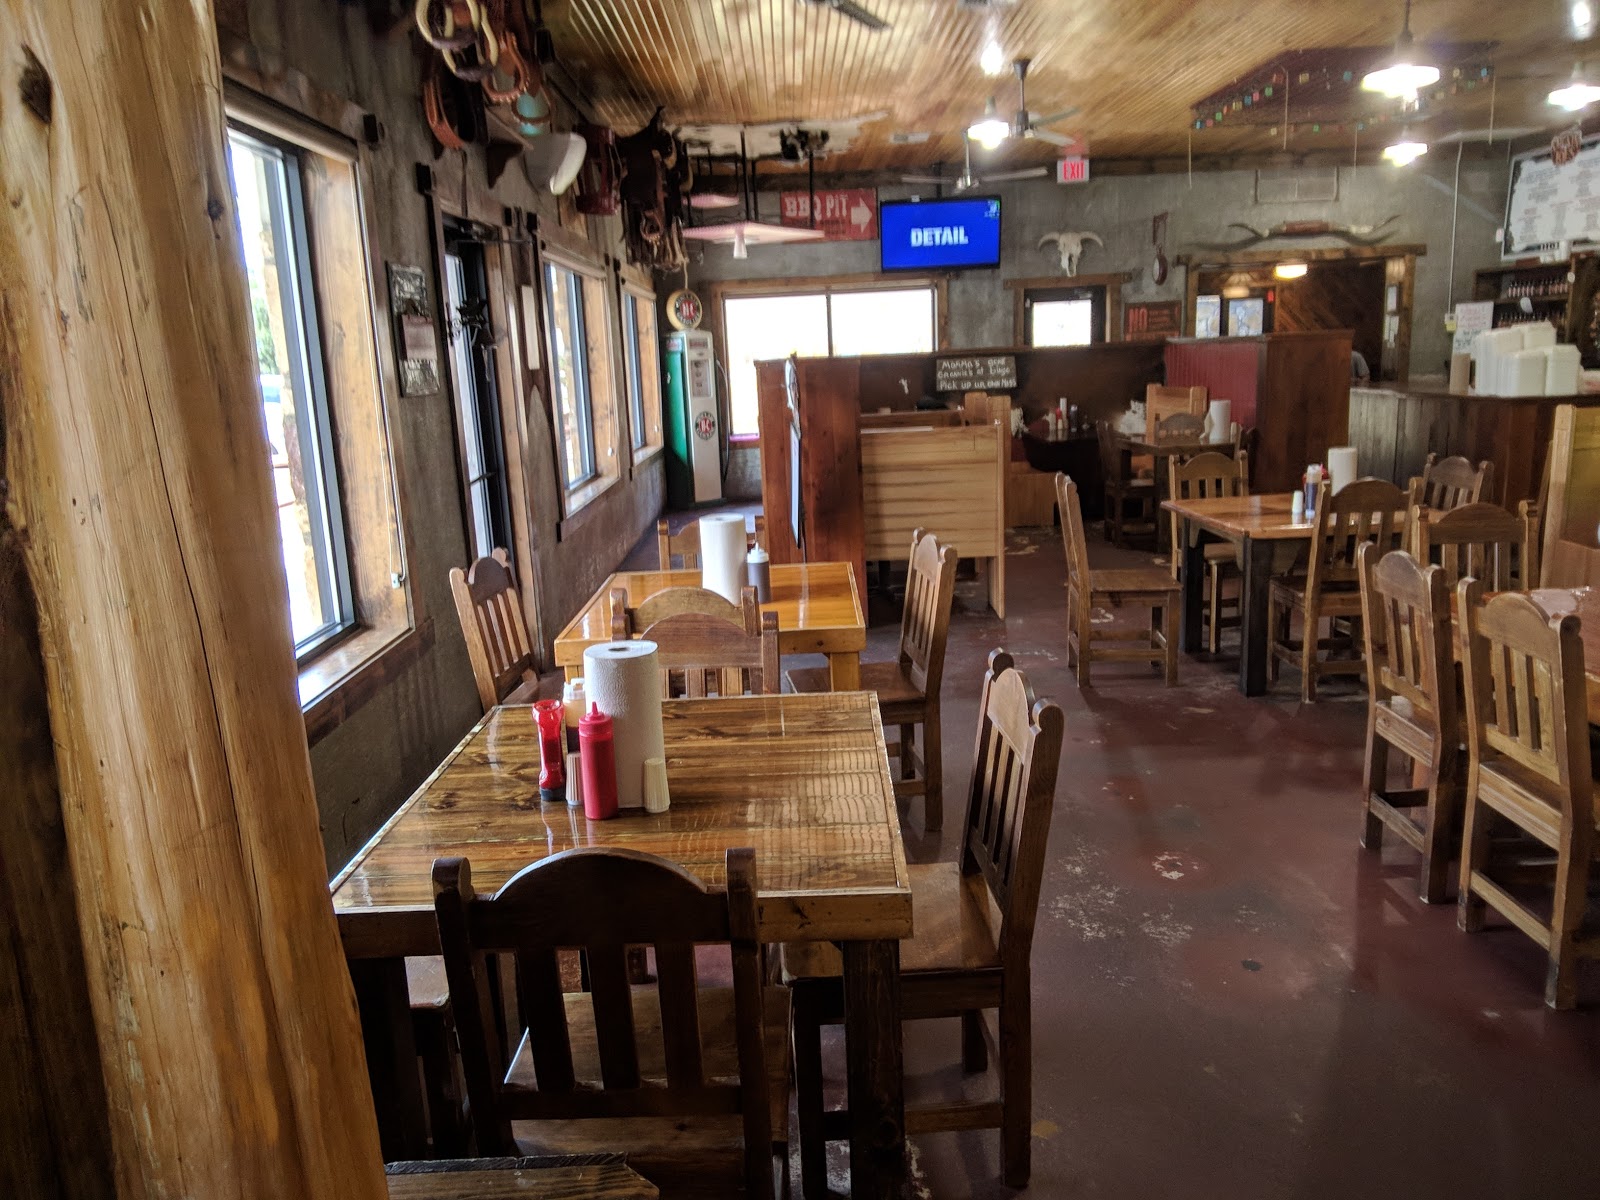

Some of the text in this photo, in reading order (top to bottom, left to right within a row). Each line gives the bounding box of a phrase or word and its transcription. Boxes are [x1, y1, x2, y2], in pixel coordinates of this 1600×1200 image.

[1063, 160, 1085, 180] EXIT
[826, 194, 849, 218] PIT
[910, 226, 969, 247] DETAIL
